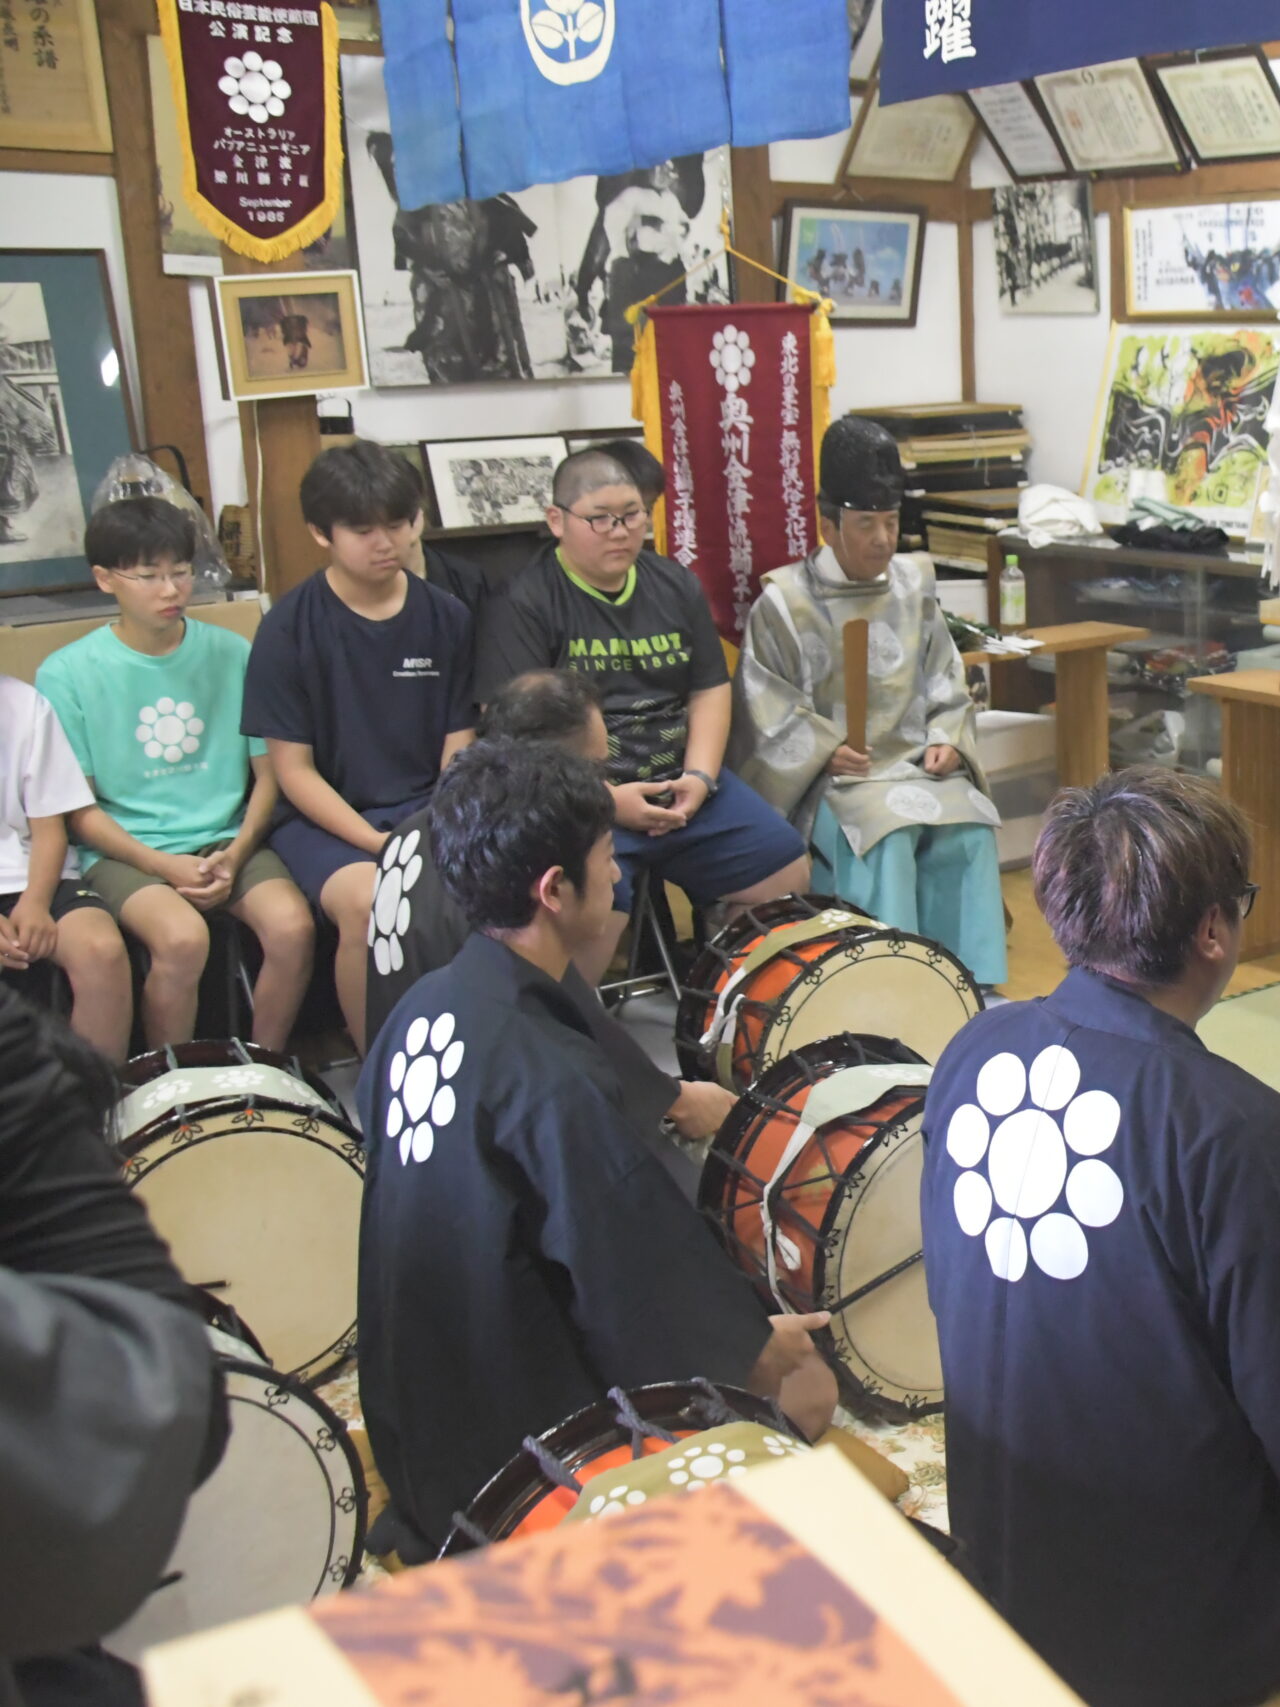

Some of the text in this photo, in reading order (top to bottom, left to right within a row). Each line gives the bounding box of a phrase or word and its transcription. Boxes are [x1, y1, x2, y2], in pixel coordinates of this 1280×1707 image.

[25, 0, 59, 69] の系譜
[208, 20, 294, 43] 公演記念
[223, 126, 296, 141] オーストラリア
[238, 196, 293, 209] September
[246, 210, 285, 223] 1985
[568, 632, 682, 657] MAMMUT
[568, 658, 633, 672] SINCE
